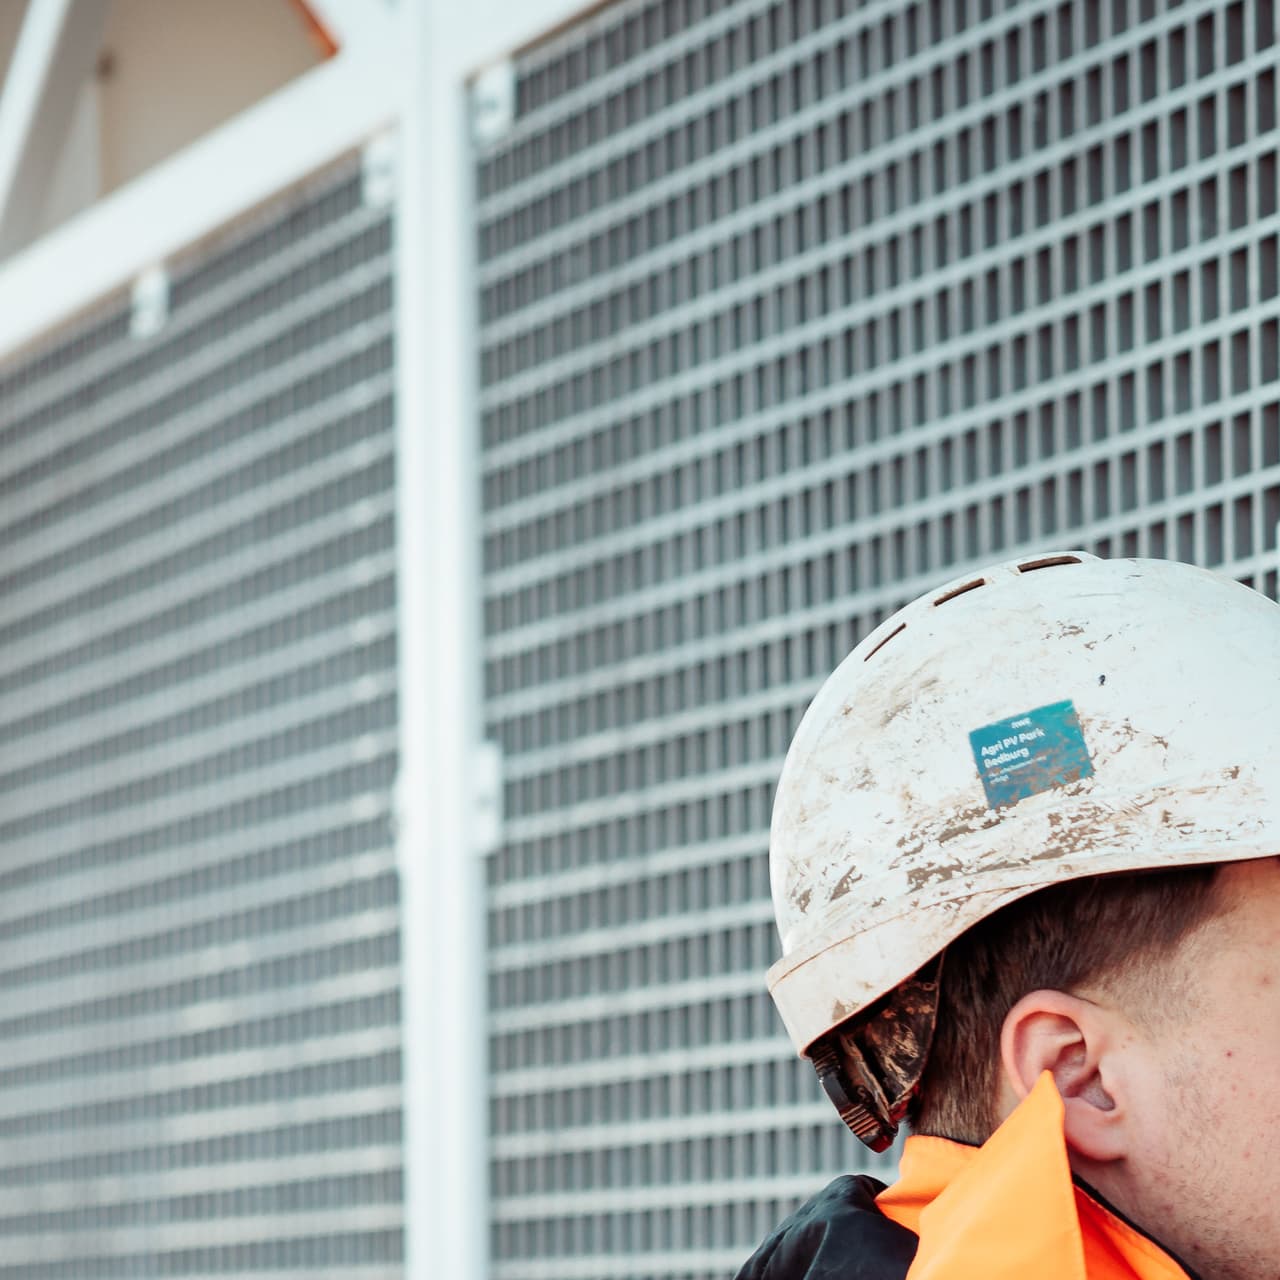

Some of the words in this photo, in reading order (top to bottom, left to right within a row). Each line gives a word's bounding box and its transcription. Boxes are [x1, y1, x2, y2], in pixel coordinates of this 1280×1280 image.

[981, 740, 1003, 757] Agri
[1003, 735, 1018, 748] PV
[1019, 728, 1046, 743] Park
